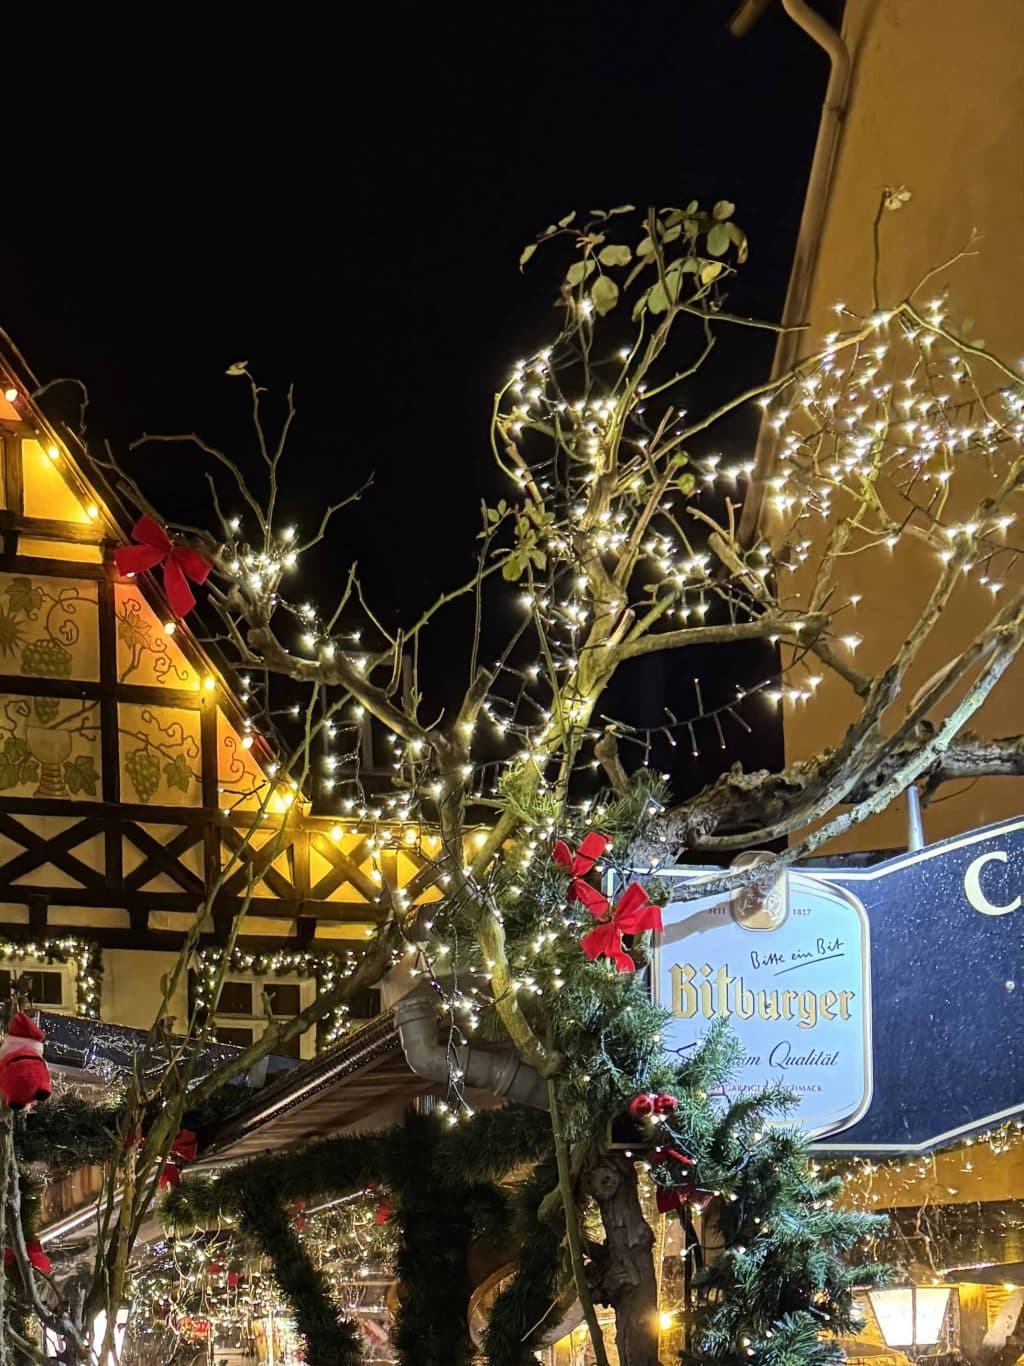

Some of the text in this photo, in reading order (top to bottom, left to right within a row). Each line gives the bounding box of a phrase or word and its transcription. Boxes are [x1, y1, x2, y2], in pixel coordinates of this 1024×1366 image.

[964, 850, 1022, 916] C
[750, 937, 845, 970] Bitte ein Bit
[669, 963, 856, 1030] Bitburger
[768, 1040, 840, 1070] Qualität
